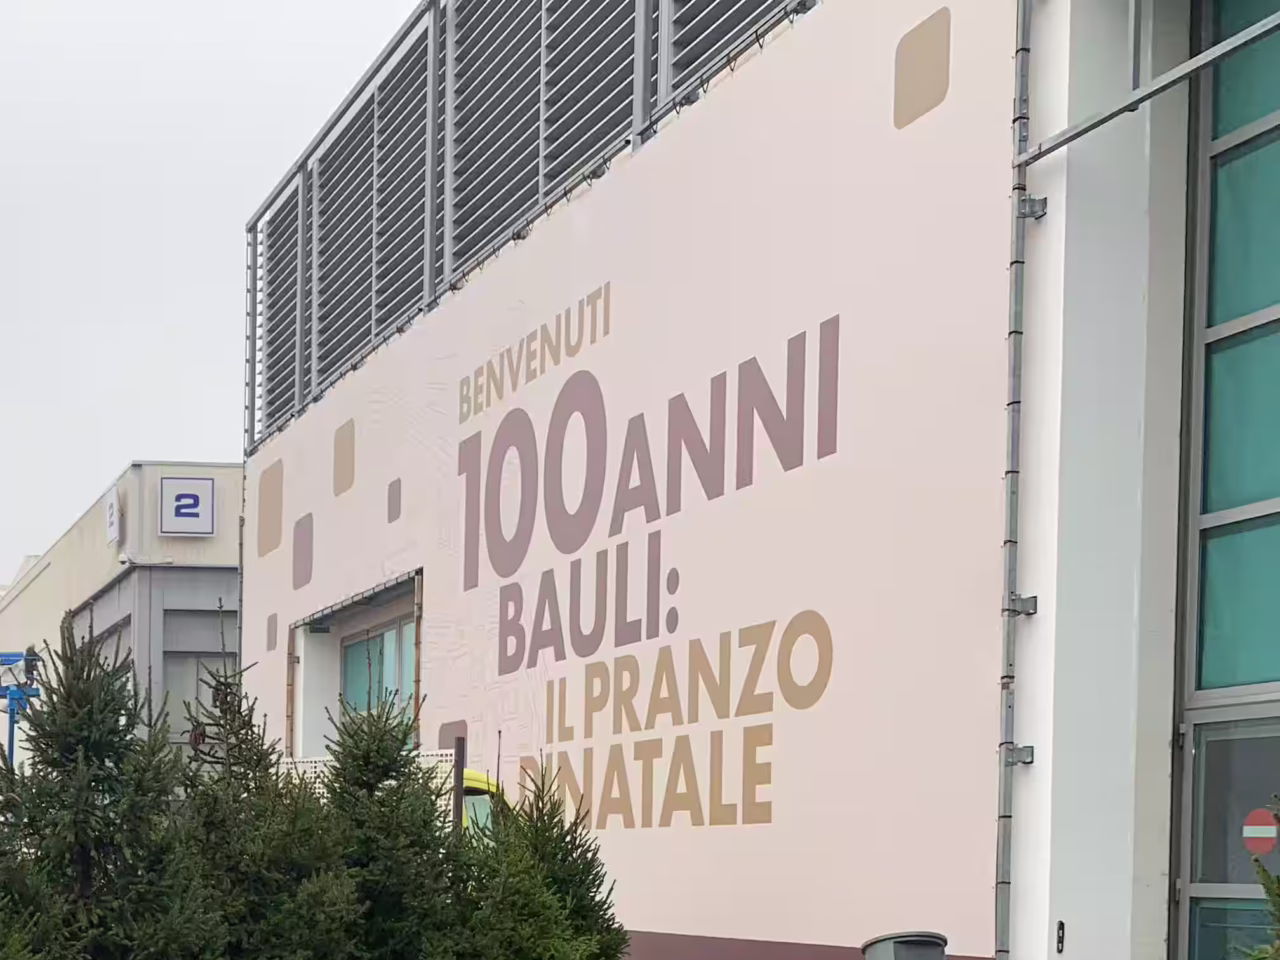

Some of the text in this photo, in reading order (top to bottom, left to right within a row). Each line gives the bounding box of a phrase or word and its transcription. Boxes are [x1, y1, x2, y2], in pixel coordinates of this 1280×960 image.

[458, 280, 611, 425] BENVENUTI
[174, 493, 200, 518] 2
[457, 313, 840, 592] 100 ANNI
[498, 529, 680, 676] BAULI:
[545, 609, 834, 745] IL PRANZO
[558, 723, 774, 830] NATALE
